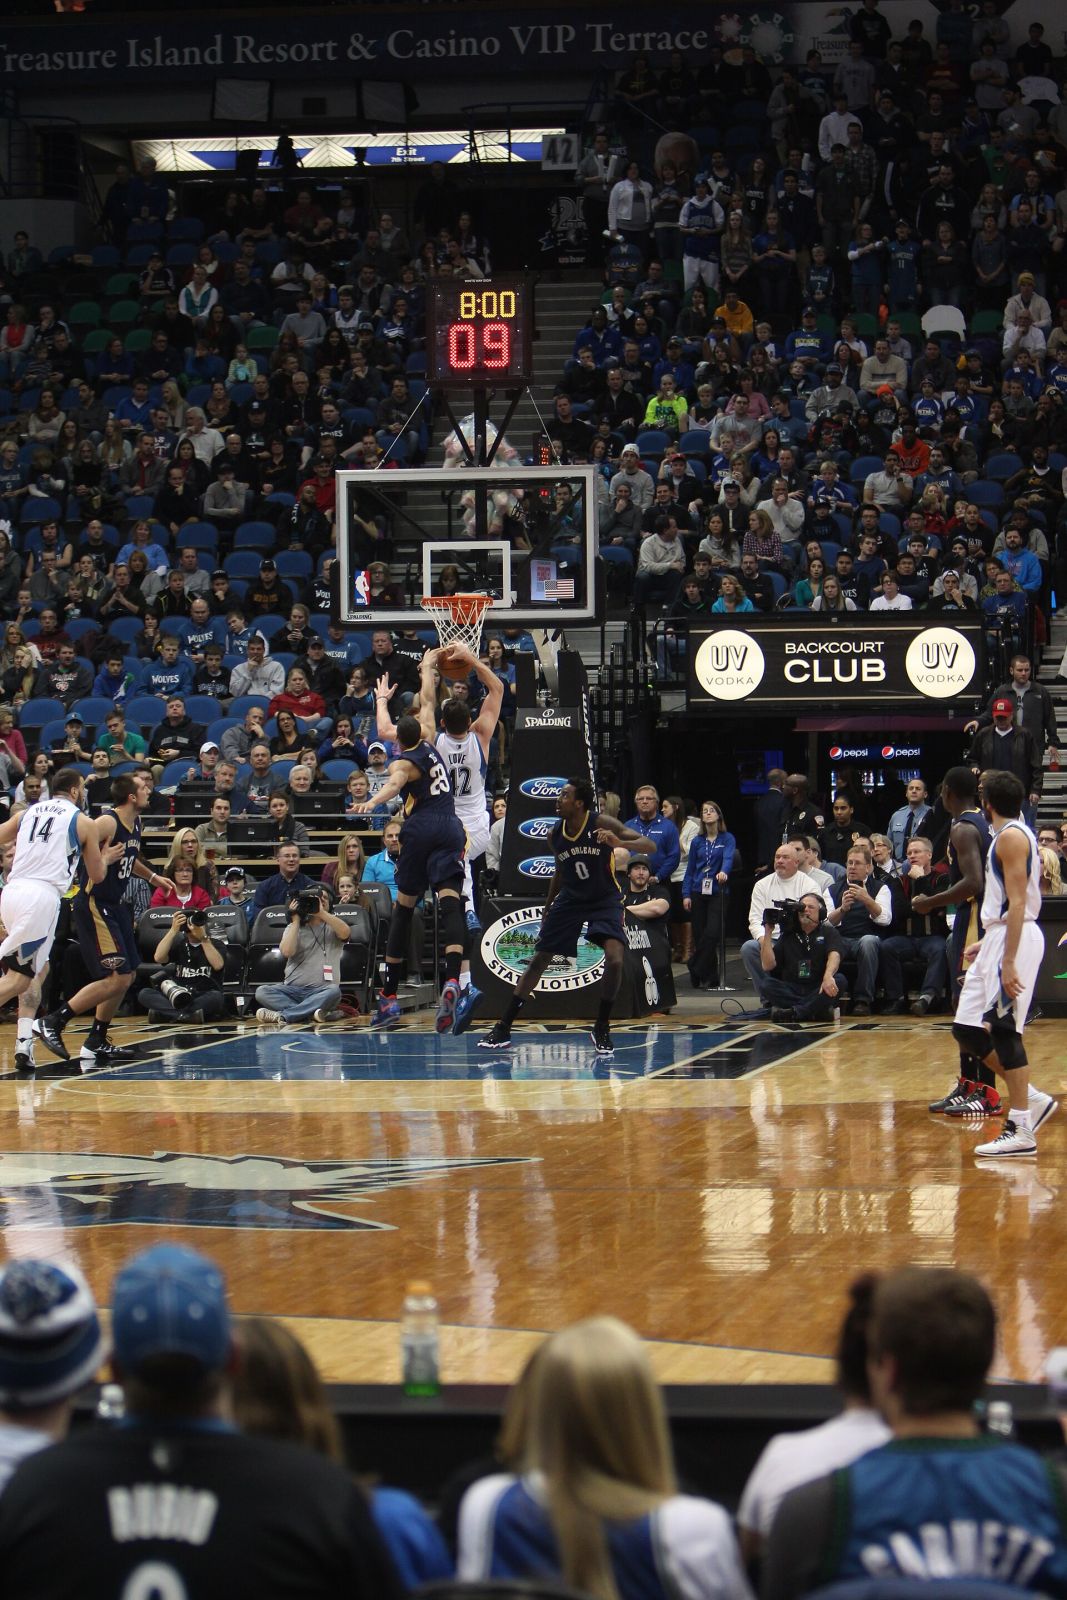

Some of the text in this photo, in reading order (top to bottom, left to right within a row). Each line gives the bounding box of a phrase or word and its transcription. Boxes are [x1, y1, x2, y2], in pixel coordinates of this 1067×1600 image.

[126, 34, 223, 67] Island
[233, 35, 338, 64] Resort
[347, 33, 377, 60] &
[387, 29, 500, 59] Casino
[509, 24, 576, 55] VIP
[586, 23, 708, 52] Terrace
[396, 147, 417, 156] Exit
[546, 138, 573, 163] 42
[460, 291, 515, 318] 8:00
[450, 324, 508, 367] 09
[187, 631, 213, 644] WOLVES
[785, 641, 885, 654] BACKCOURT
[710, 645, 748, 671] UV
[921, 643, 959, 668] UV
[784, 658, 886, 683] CLUB
[151, 674, 180, 685] WOLVES
[706, 677, 755, 686] VODKA
[916, 674, 965, 683] VODKA
[525, 716, 572, 728] SPALDING
[448, 753, 467, 764] LOVE
[843, 748, 868, 757] pepsi
[895, 747, 920, 757] pepsi
[28, 816, 55, 843] 14
[571, 846, 601, 856] ORLEANS
[118, 856, 135, 879] 33
[530, 860, 557, 874] For
[575, 861, 590, 880] 0
[488, 960, 522, 984] STAT
